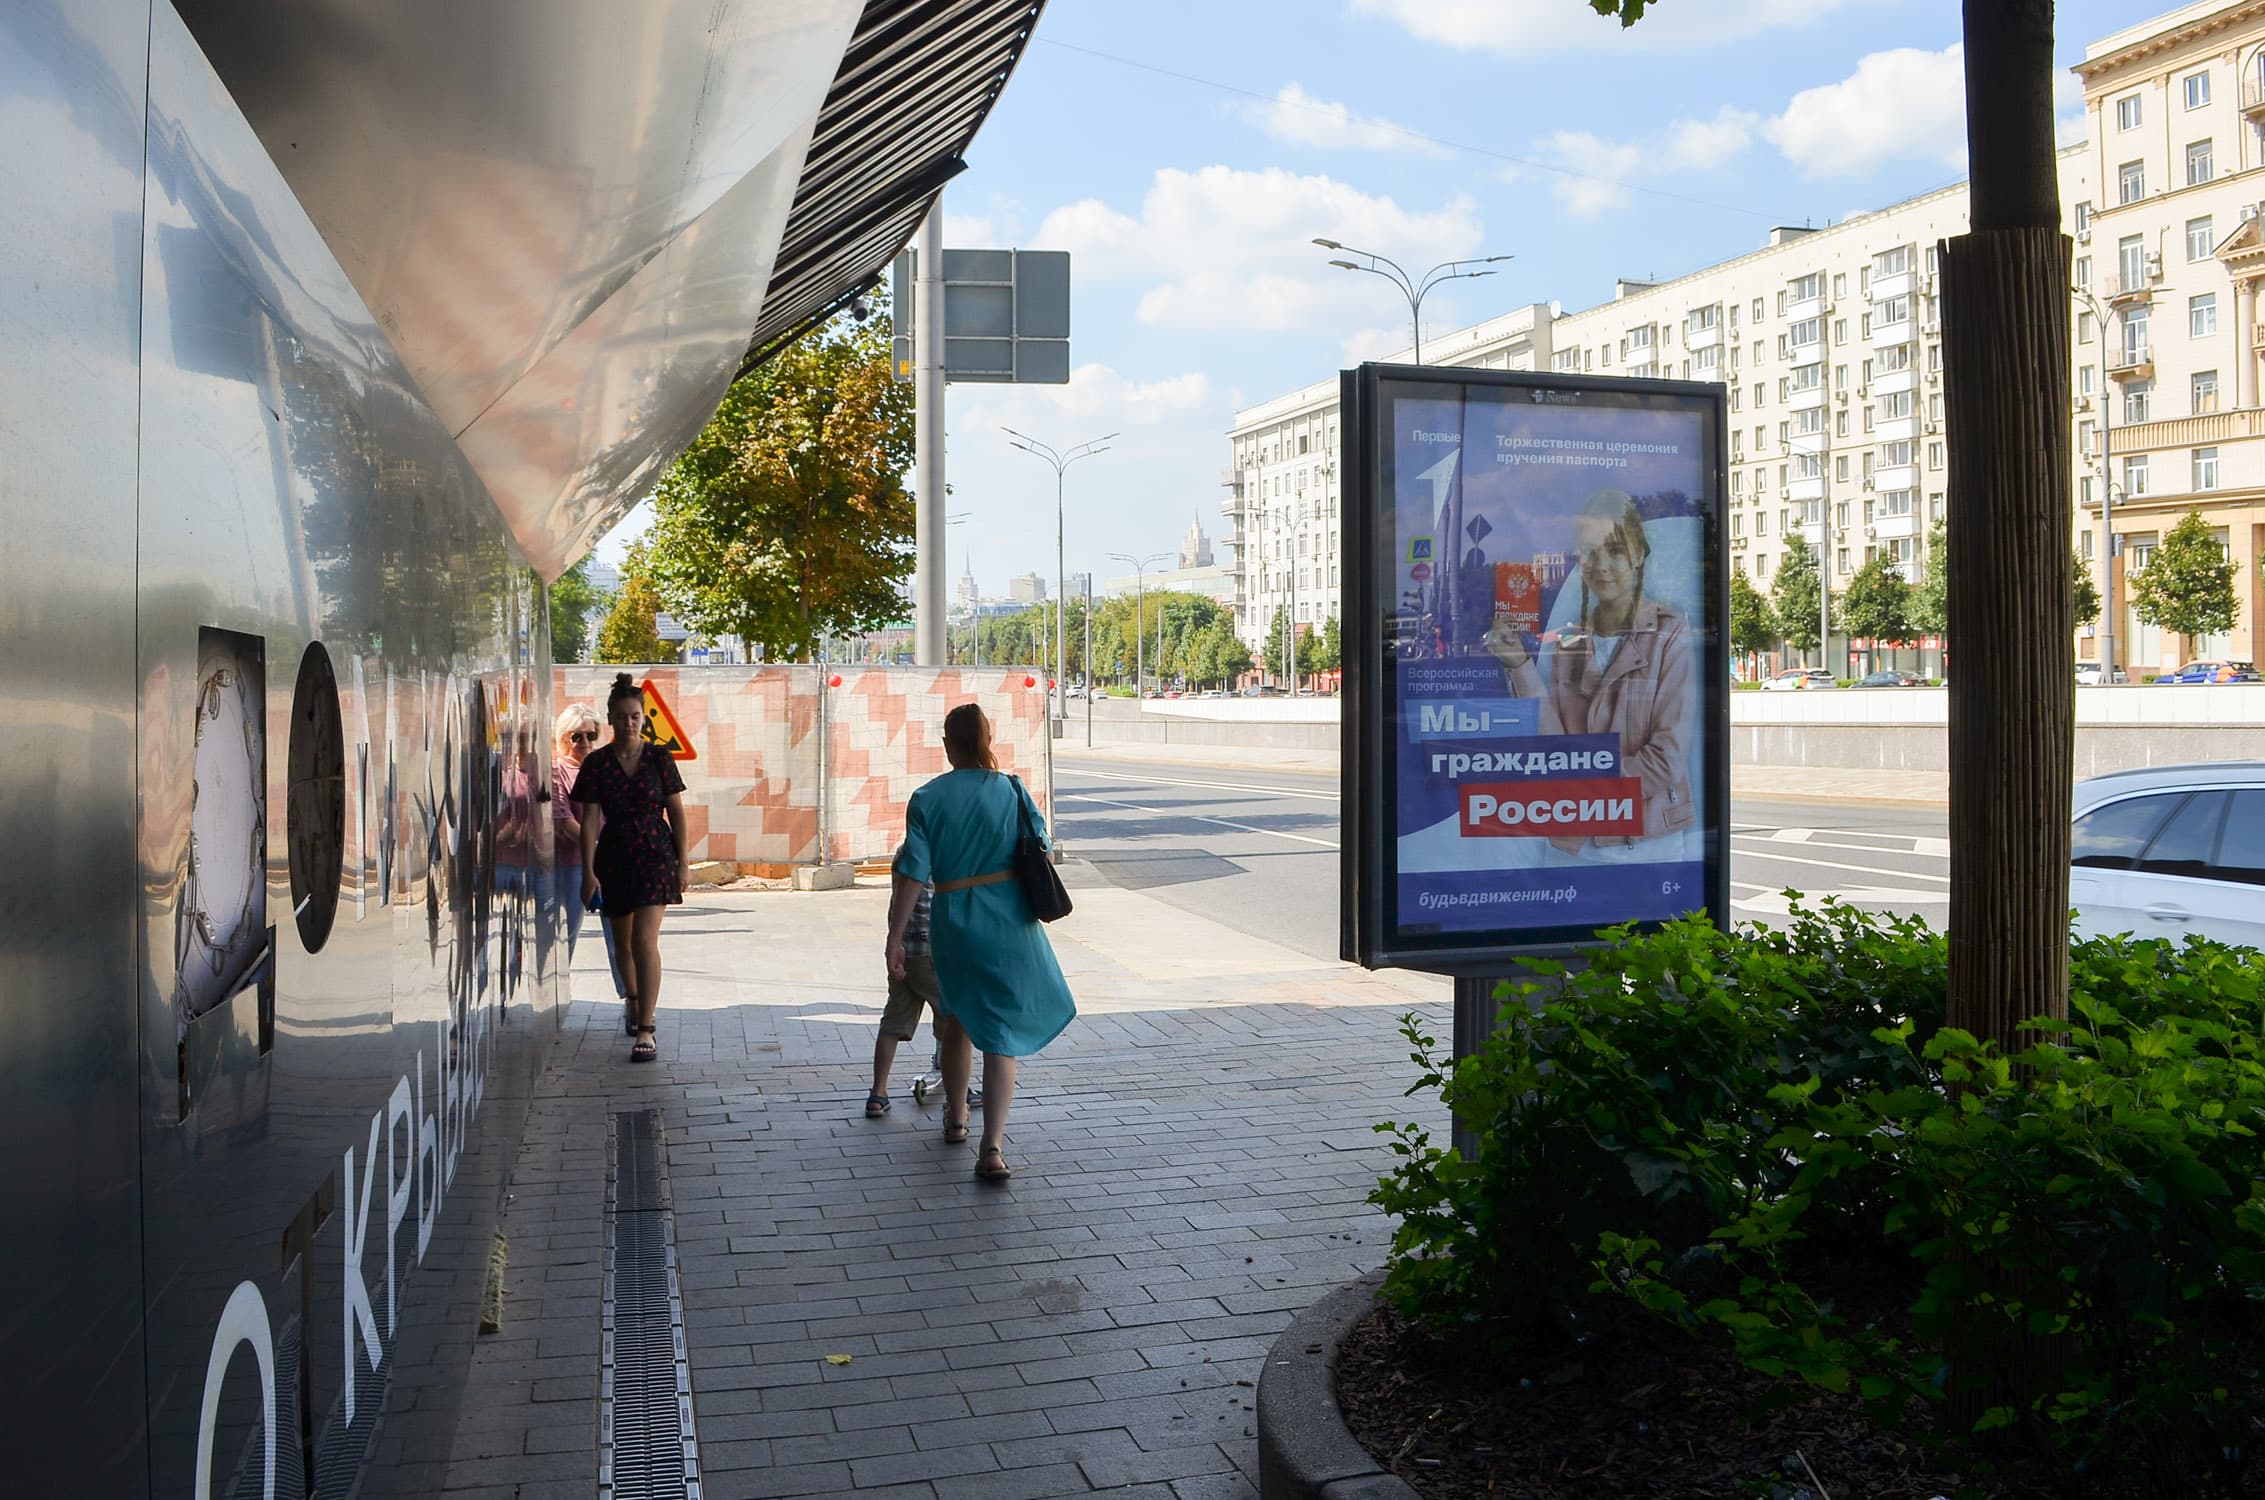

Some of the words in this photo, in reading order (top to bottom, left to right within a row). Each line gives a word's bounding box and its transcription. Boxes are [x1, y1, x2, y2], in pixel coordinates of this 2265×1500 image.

[1412, 430, 1461, 445] Первые
[1496, 435, 1604, 450] Торжественная
[1606, 441, 1679, 455] церемония
[1496, 452, 1564, 465] вручения
[1566, 455, 1628, 469] паспорта
[1408, 667, 1499, 680] Всероссийская
[1408, 682, 1474, 693] программа
[1431, 750, 1615, 779] граждане
[1468, 794, 1633, 825] России
[1661, 880, 1682, 895] 6+
[1419, 885, 1577, 909] будьвдвижении.рф
